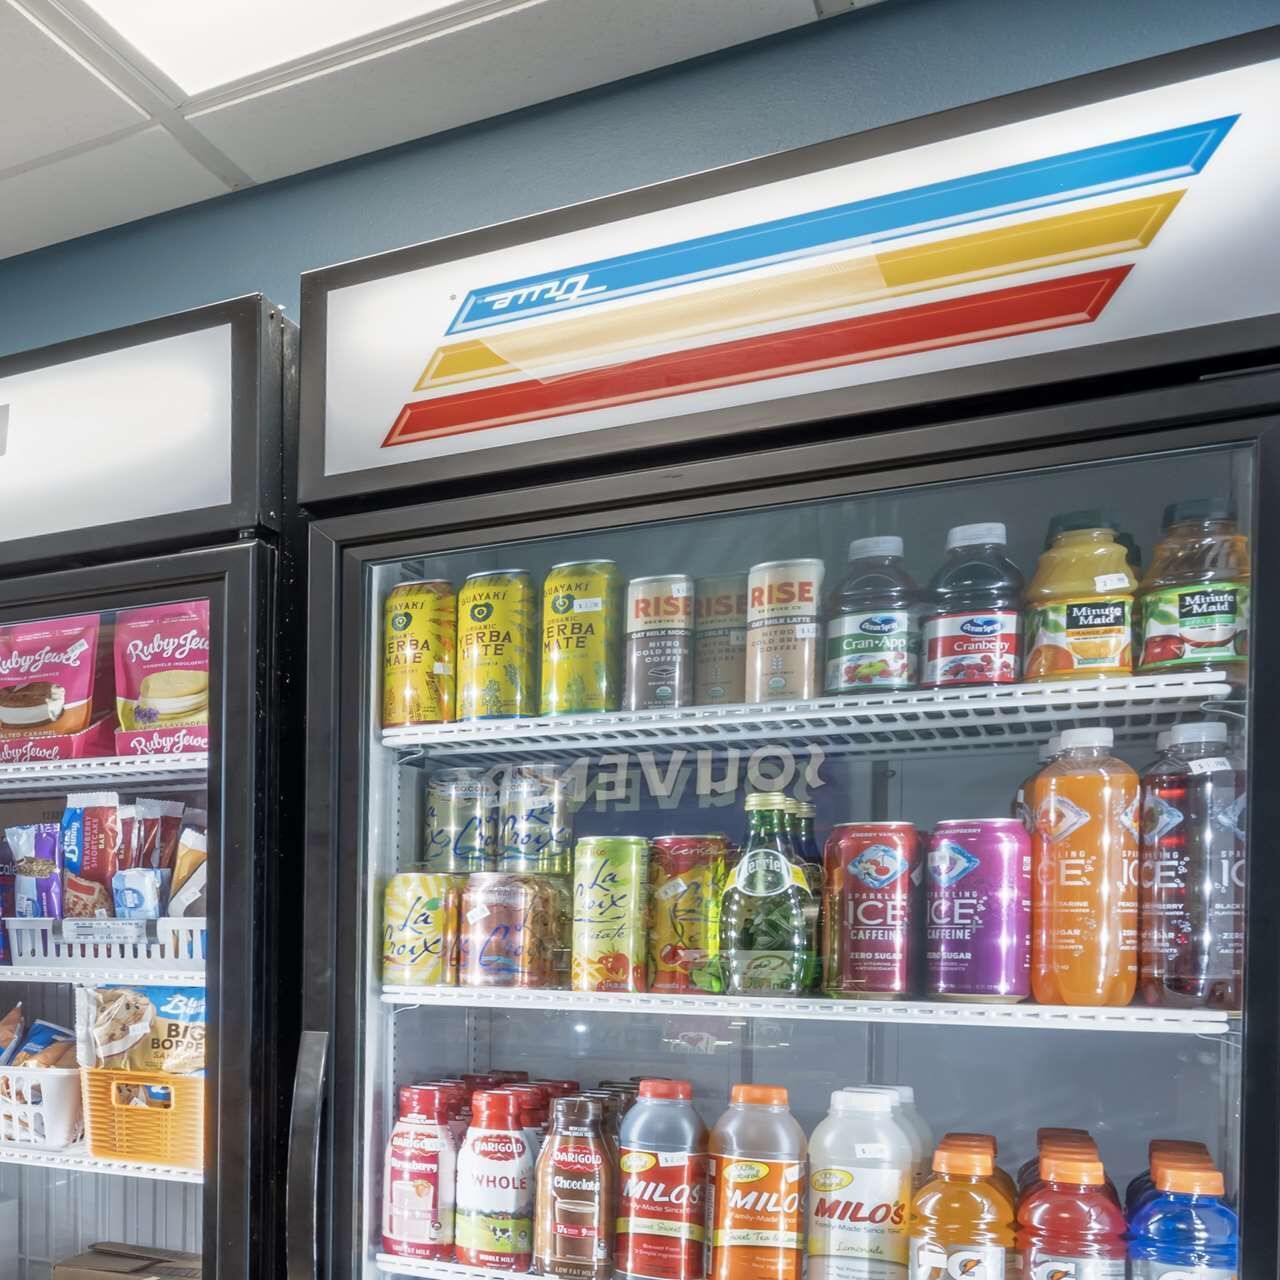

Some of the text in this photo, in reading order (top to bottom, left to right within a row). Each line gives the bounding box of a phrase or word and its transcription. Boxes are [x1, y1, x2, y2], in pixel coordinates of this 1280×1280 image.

[484, 273, 607, 311] true
[751, 581, 814, 609] RISE
[1184, 594, 1235, 606] Minute
[634, 595, 694, 619] RISE
[1072, 606, 1122, 617] Minute
[1191, 603, 1229, 615] Maid
[765, 618, 785, 626] MILK
[787, 616, 811, 624] LATTE
[1079, 614, 1115, 625] Maid
[128, 629, 210, 663] Ruby Jew
[649, 640, 680, 648] NITRO
[953, 640, 1010, 653] Cranberry
[30, 646, 81, 673] Jewel
[130, 729, 208, 756] Ruby Jewe
[20, 742, 60, 761] Jewel
[91, 817, 99, 868] SHORTCAKE
[589, 859, 619, 892] La
[400, 896, 433, 936] La
[847, 900, 907, 926] ICE
[848, 952, 872, 960] ZERO
[167, 1023, 205, 1040] BIG
[151, 1038, 205, 1050] BOPPE
[473, 1141, 523, 1153] DARIGOLD
[553, 1152, 602, 1165] DARIGOLD
[473, 1175, 527, 1190] WHOLE
[553, 1175, 601, 1191] Chocolate
[814, 1197, 904, 1225] MILO'S
